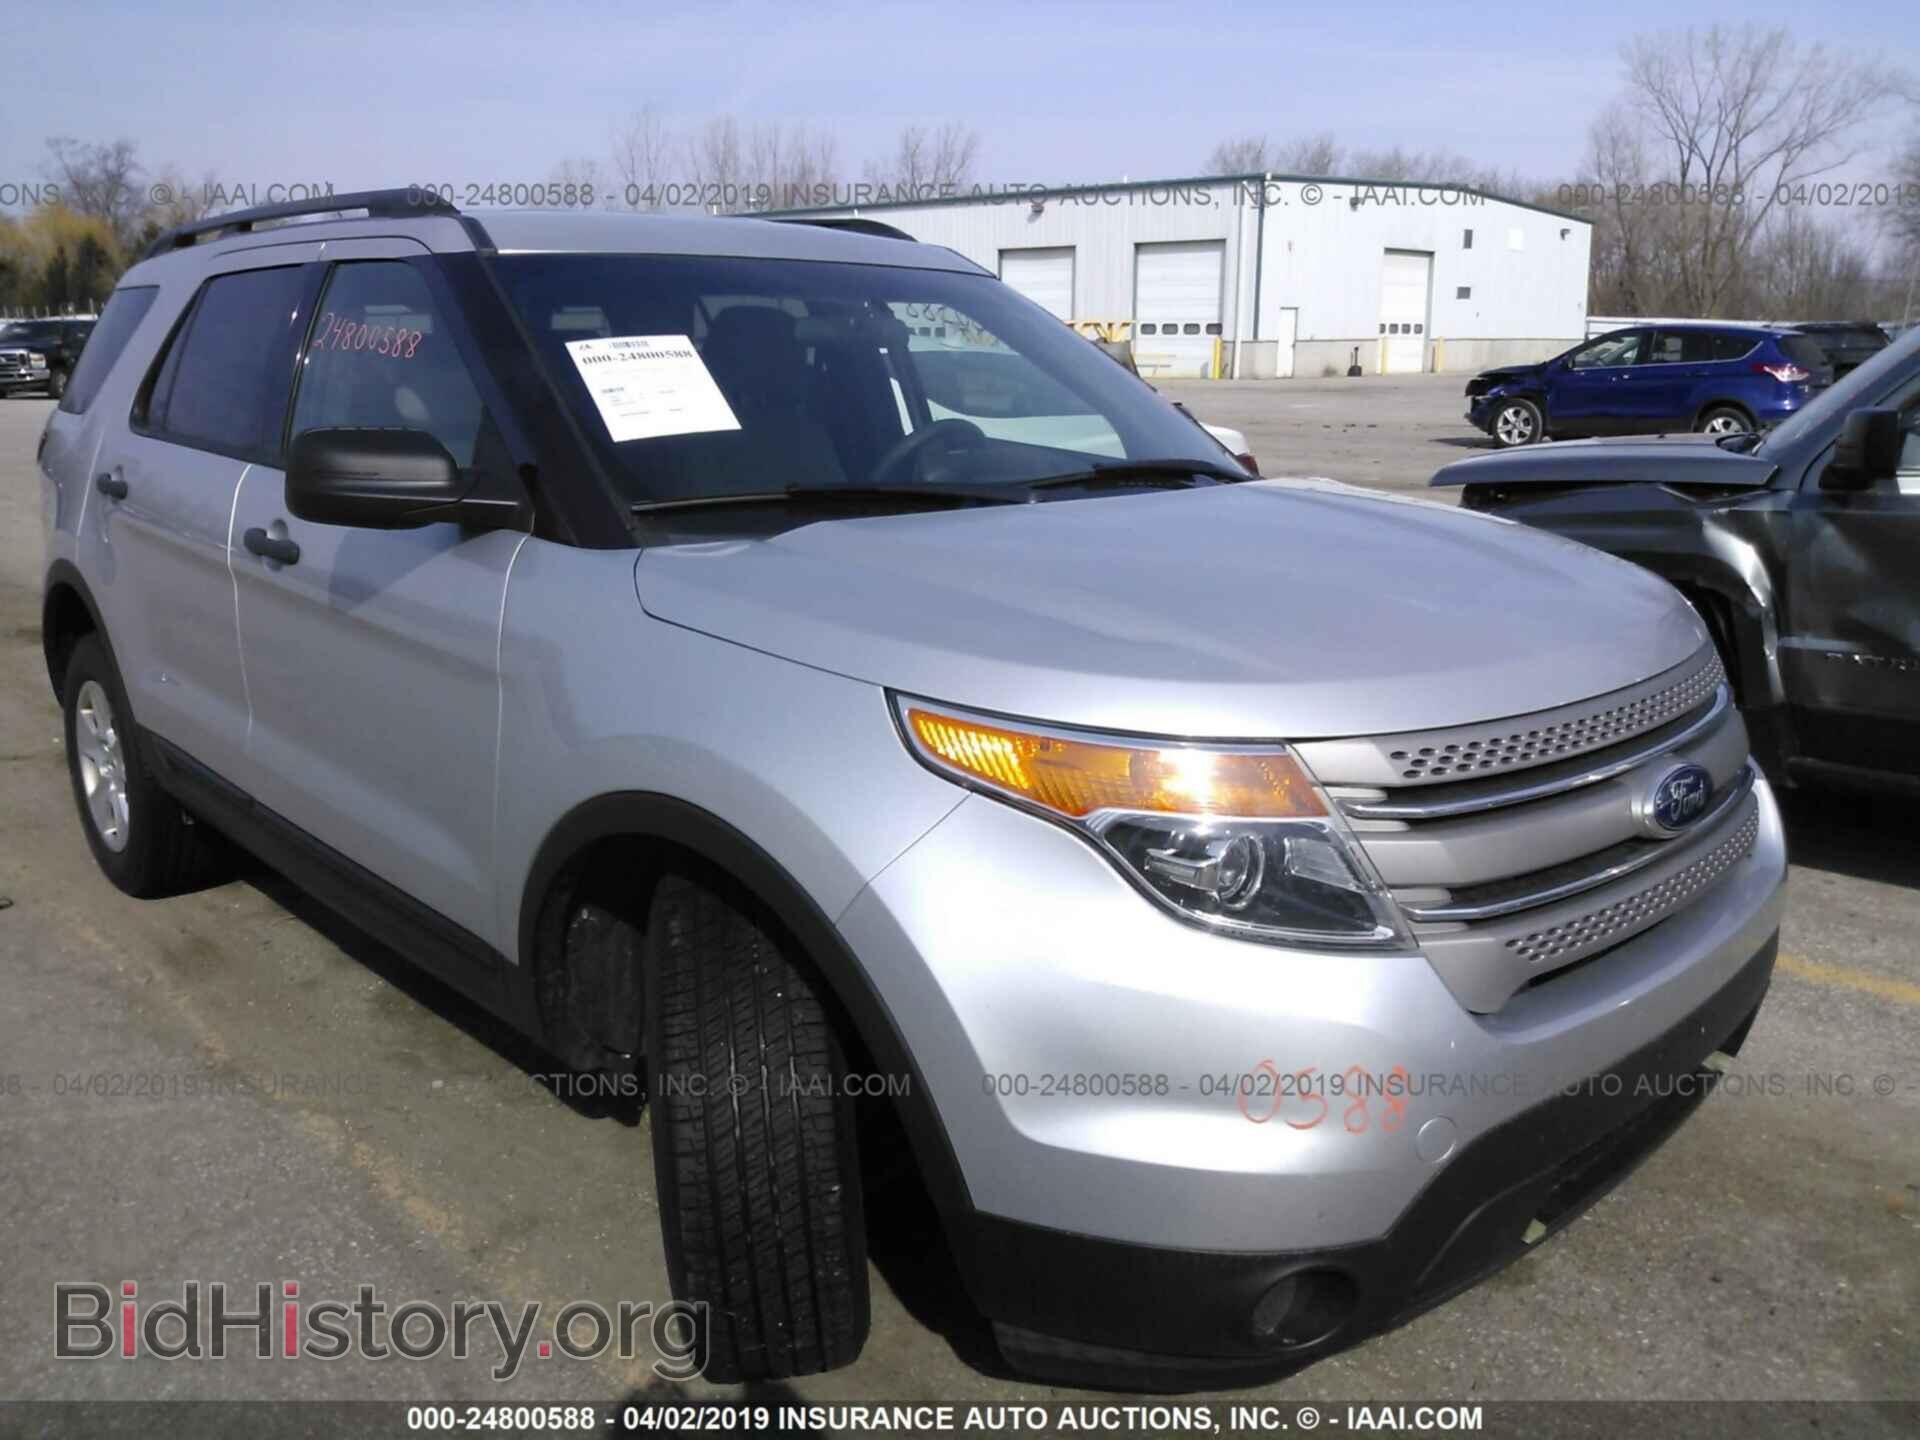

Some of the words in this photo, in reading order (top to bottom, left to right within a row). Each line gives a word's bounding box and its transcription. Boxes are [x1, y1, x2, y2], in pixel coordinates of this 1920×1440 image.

[312, 312, 423, 358] 24800588
[1656, 775, 1705, 822] Ford
[1237, 1059, 1409, 1136] 0588
